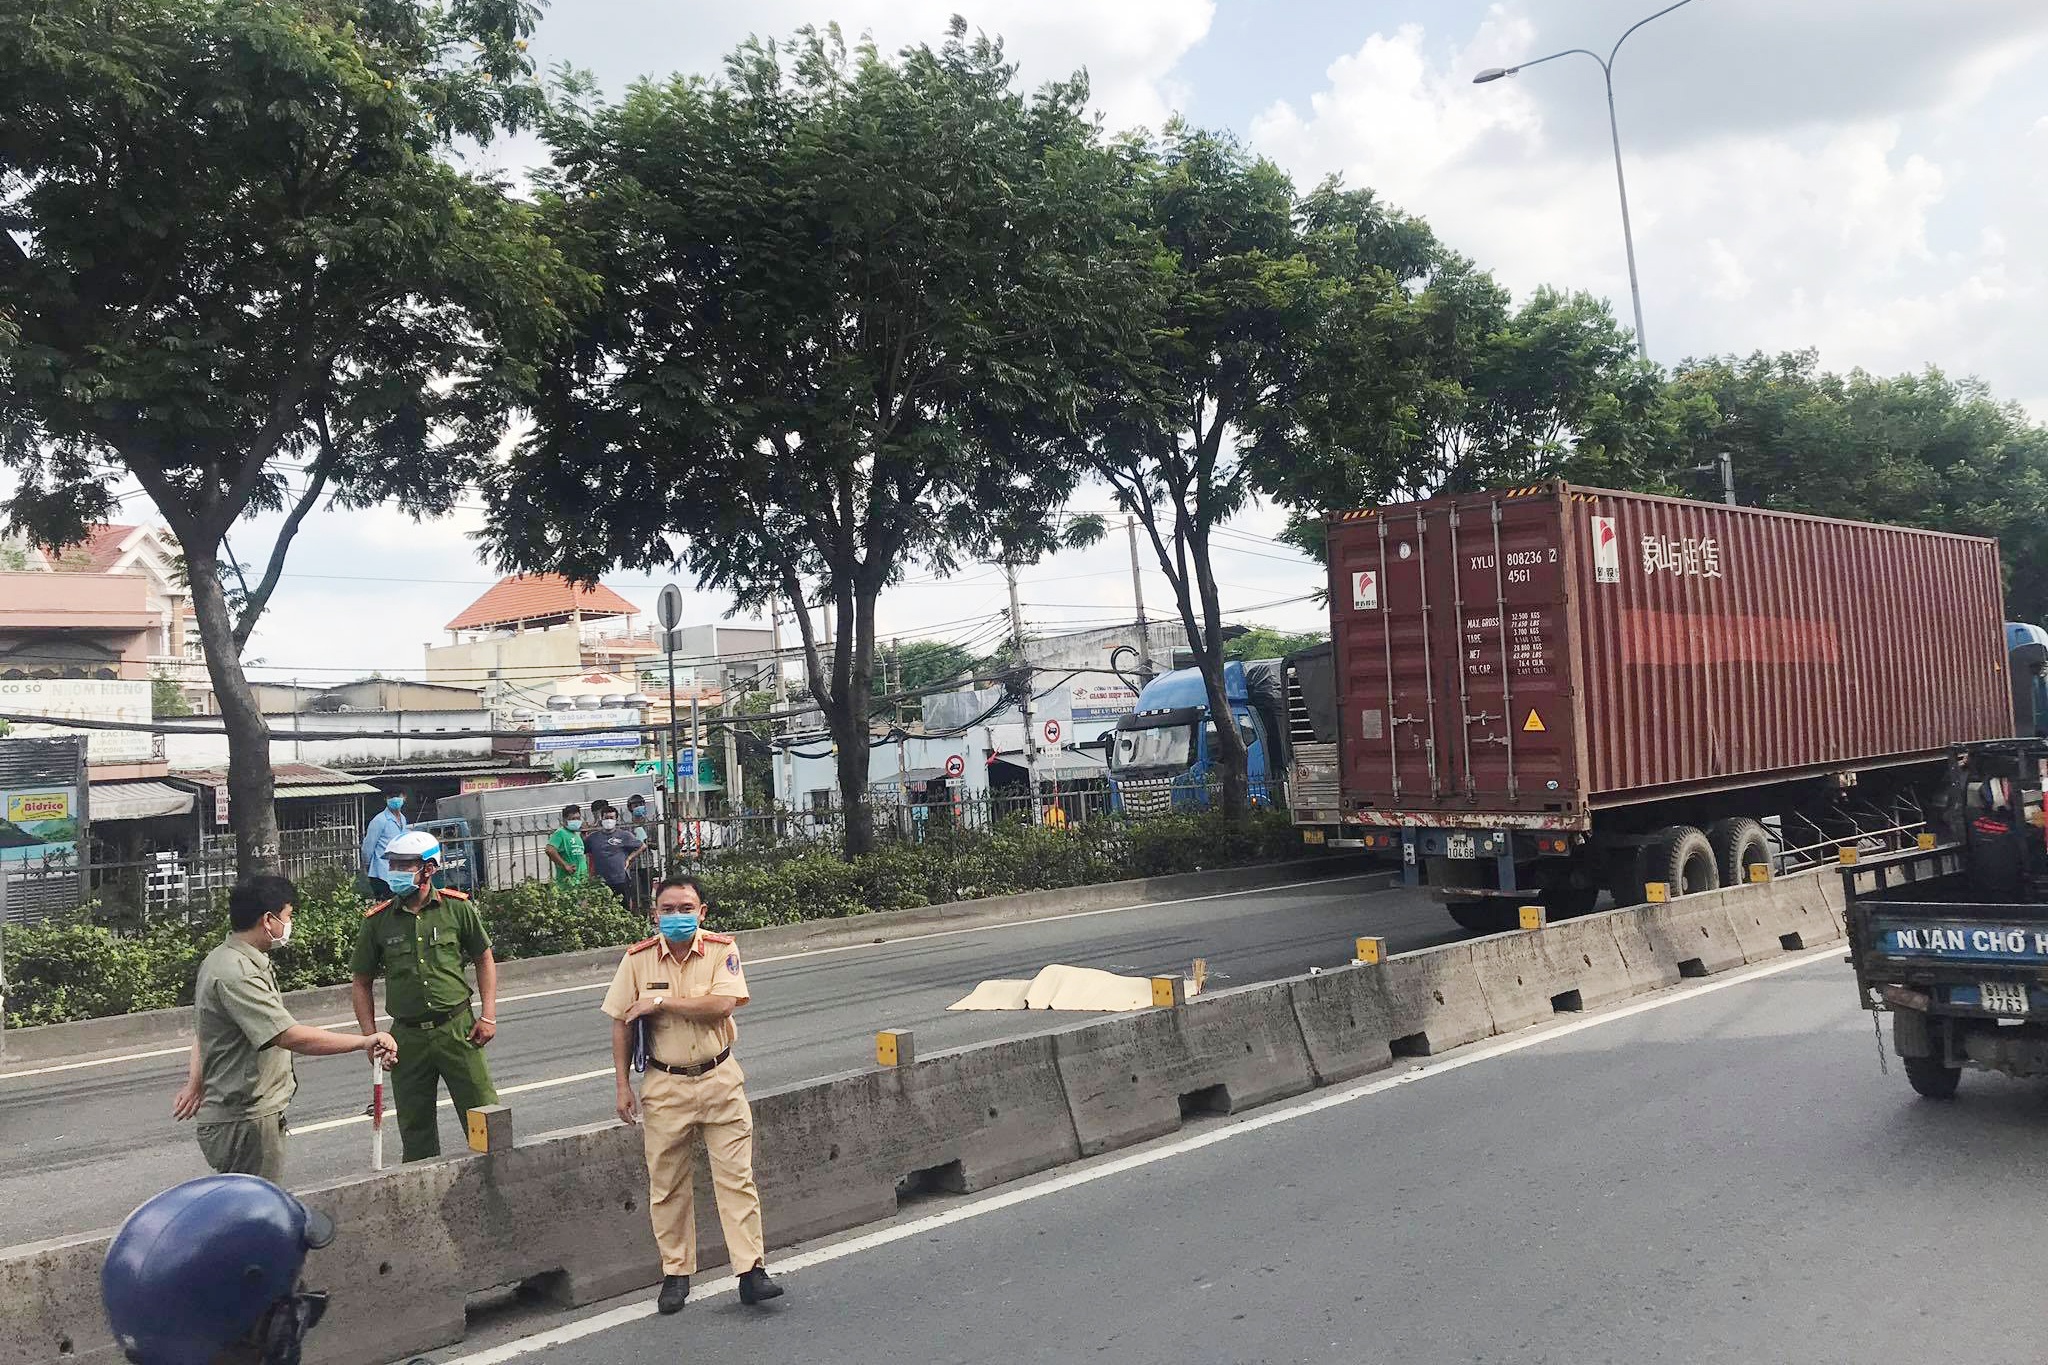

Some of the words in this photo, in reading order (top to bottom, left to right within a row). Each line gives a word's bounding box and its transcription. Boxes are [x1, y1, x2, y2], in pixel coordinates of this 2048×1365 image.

[1471, 555, 1494, 570] XYLU
[1507, 551, 1542, 566] 808236
[1549, 548, 1557, 562] 2
[1508, 569, 1531, 582] 45G1
[1469, 650, 1480, 659] NET
[25, 802, 64, 811] Bidrico
[252, 844, 277, 858] 423
[1989, 997, 2022, 1012] 2763
